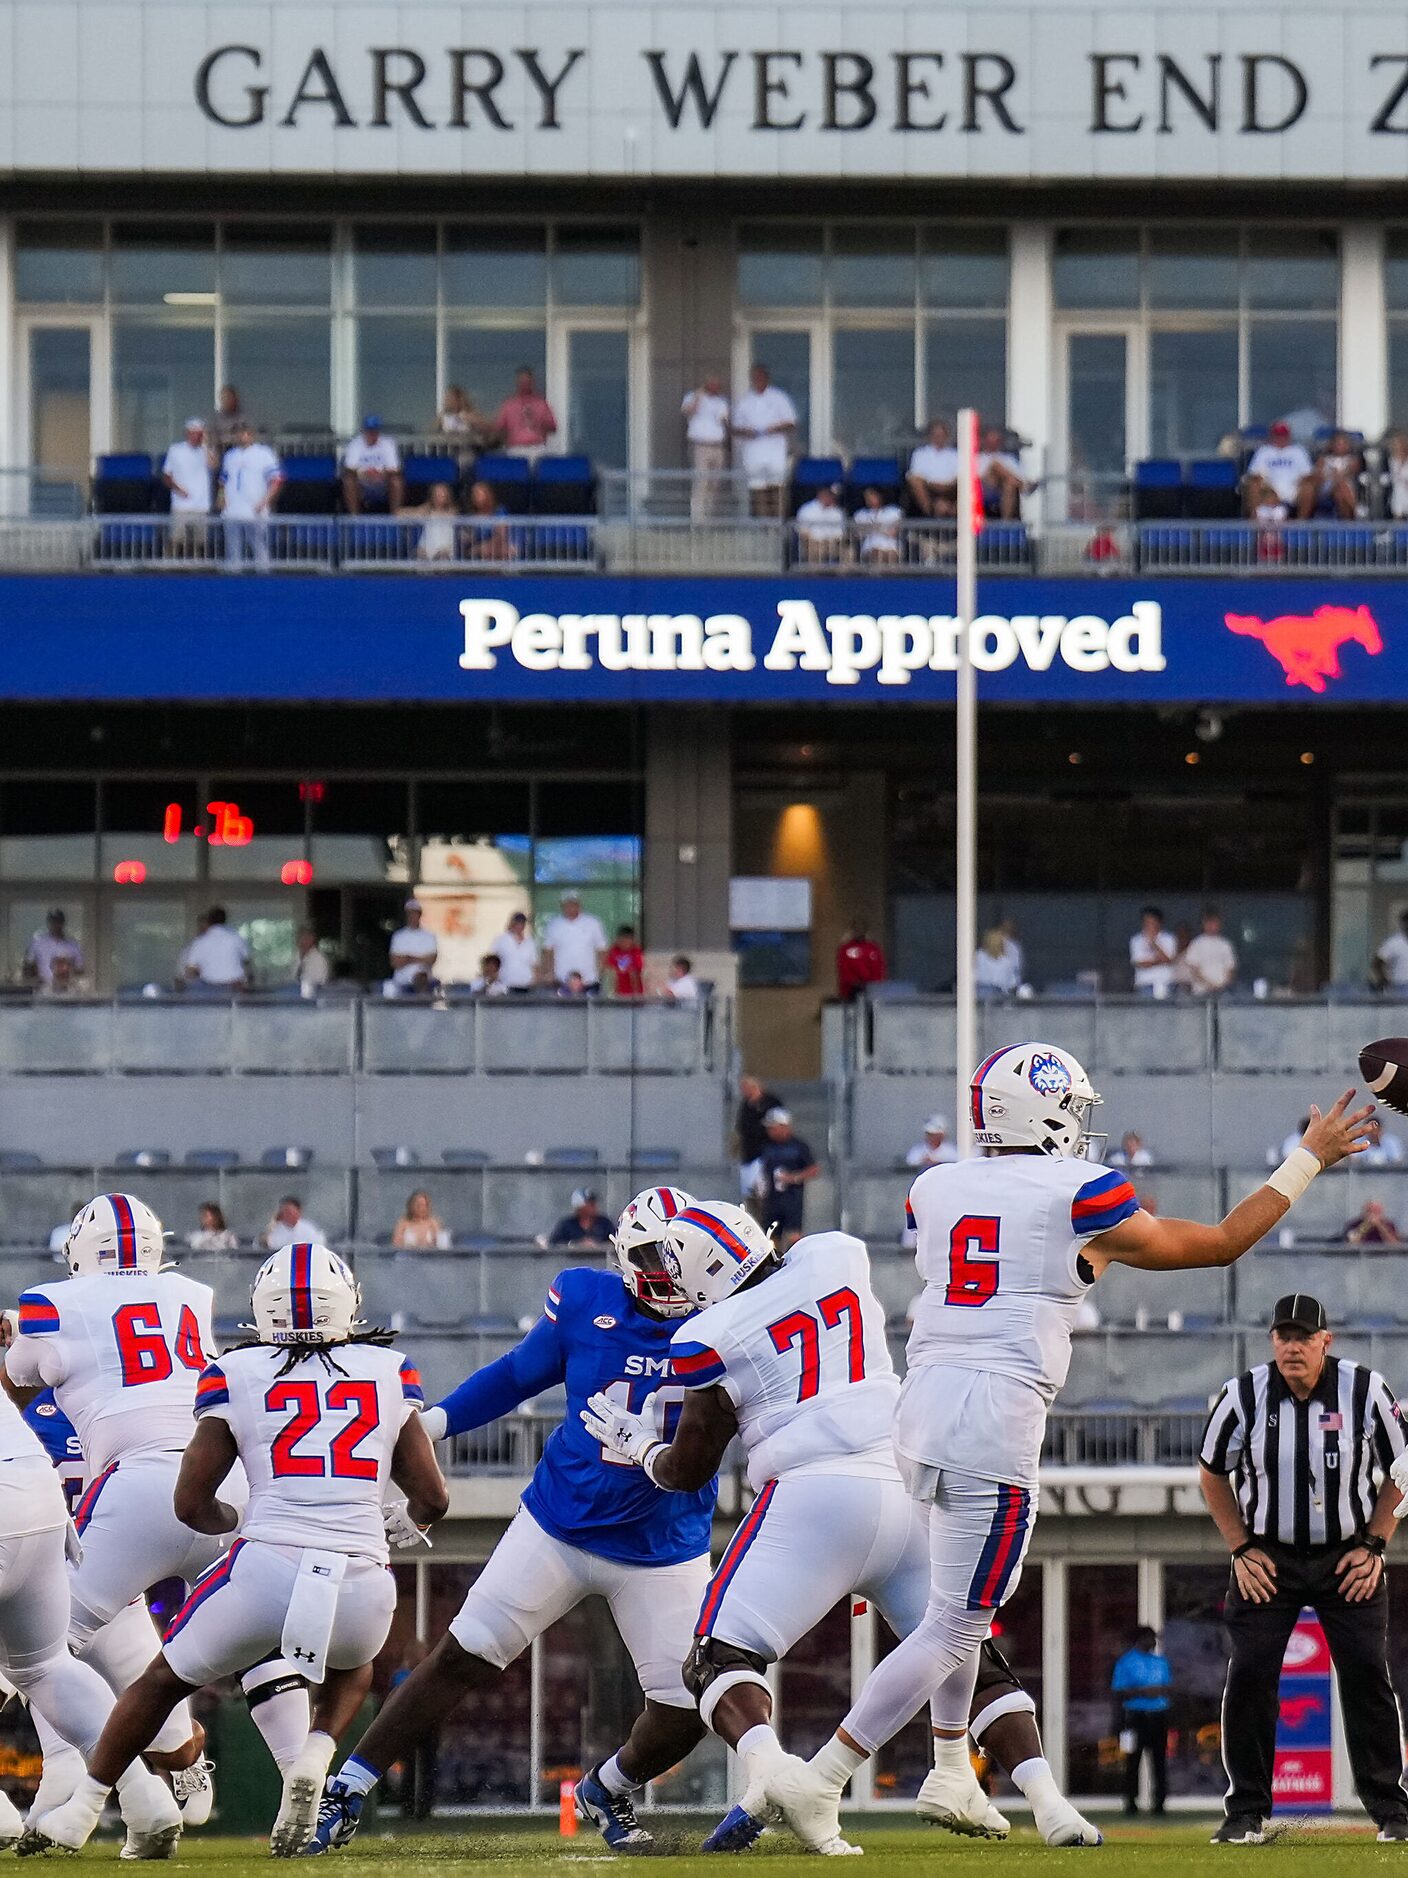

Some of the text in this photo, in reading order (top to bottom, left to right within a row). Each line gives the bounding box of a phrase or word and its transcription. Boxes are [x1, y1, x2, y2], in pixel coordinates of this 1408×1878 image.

[196, 46, 584, 130] GARRY
[645, 52, 1024, 134] WEBER
[1090, 54, 1308, 133] END
[459, 599, 1166, 684] Peruna Approved
[944, 1214, 1001, 1307] 6
[111, 1302, 208, 1388] 64
[272, 1331, 324, 1342] HUSKIES
[624, 1355, 676, 1377] SM
[765, 1286, 866, 1404] 77
[264, 1380, 380, 1482] 22
[1269, 1413, 1278, 1428] S
[1325, 1452, 1338, 1469] U
